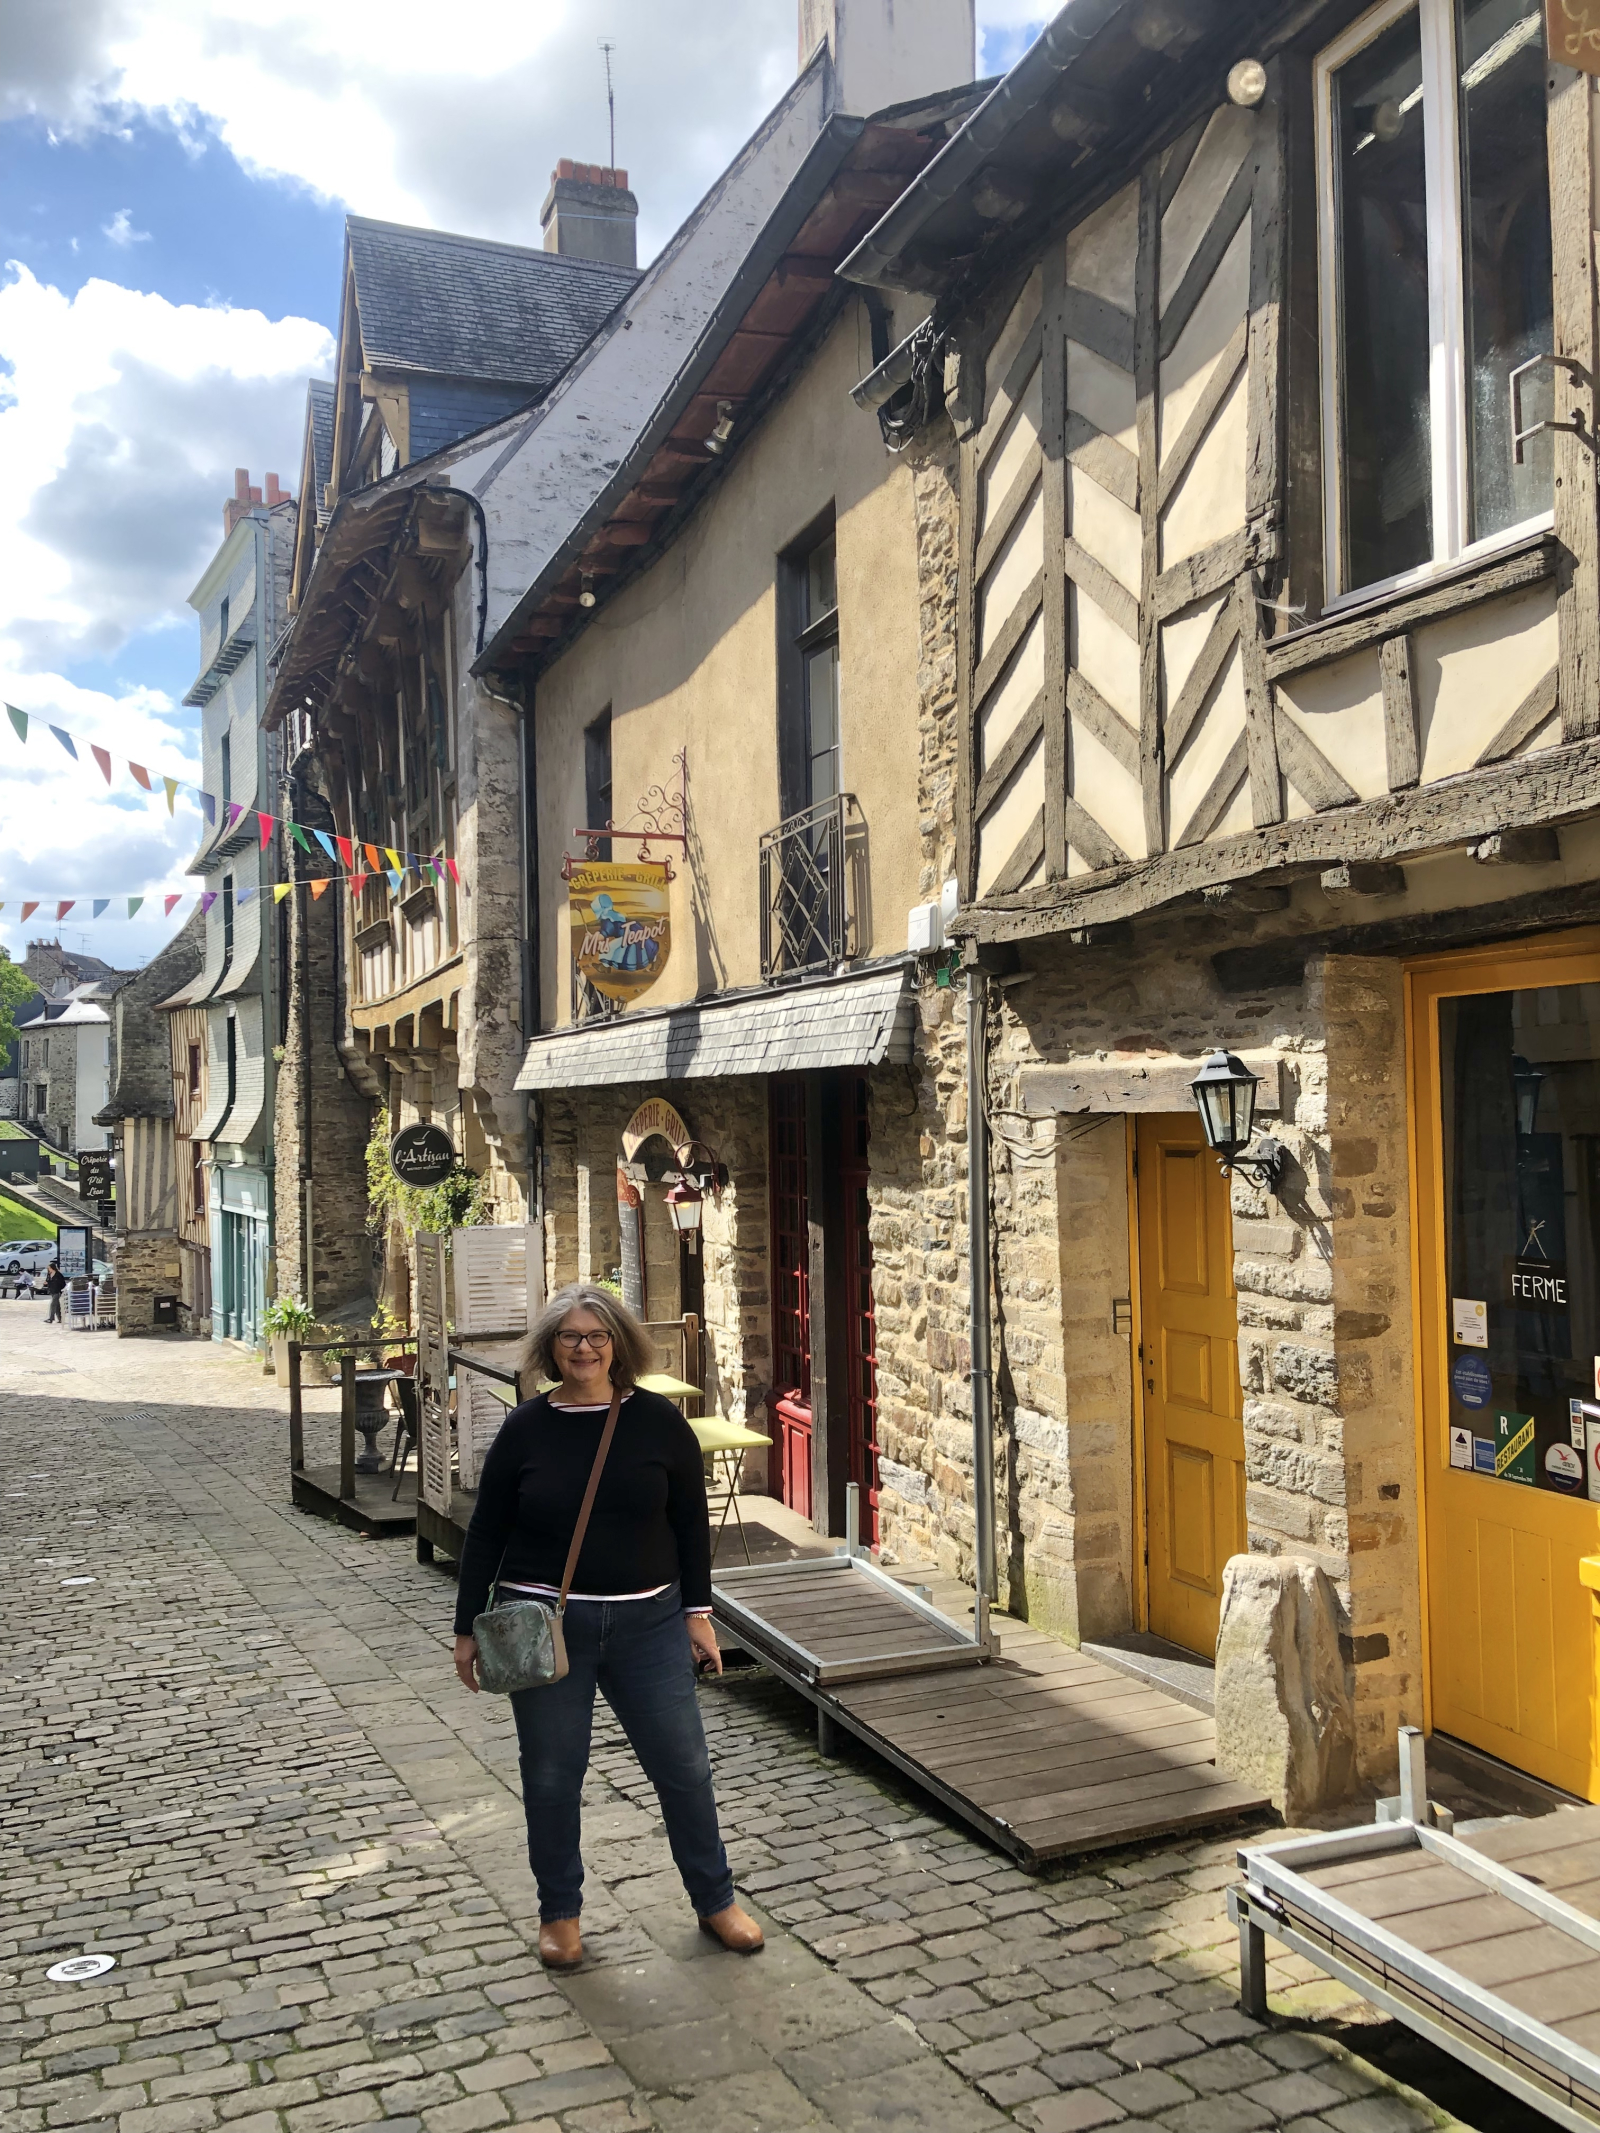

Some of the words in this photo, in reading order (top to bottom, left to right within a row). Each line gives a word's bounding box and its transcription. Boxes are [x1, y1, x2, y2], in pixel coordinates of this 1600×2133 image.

[635, 871, 666, 892] GRILL
[579, 931, 610, 960] Mrs
[621, 916, 669, 948] Teapot
[395, 1147, 450, 1169] l'Artisan
[1511, 1274, 1567, 1304] FERME
[1500, 1415, 1509, 1435] R
[1496, 1422, 1533, 1473] RESTAURANT
